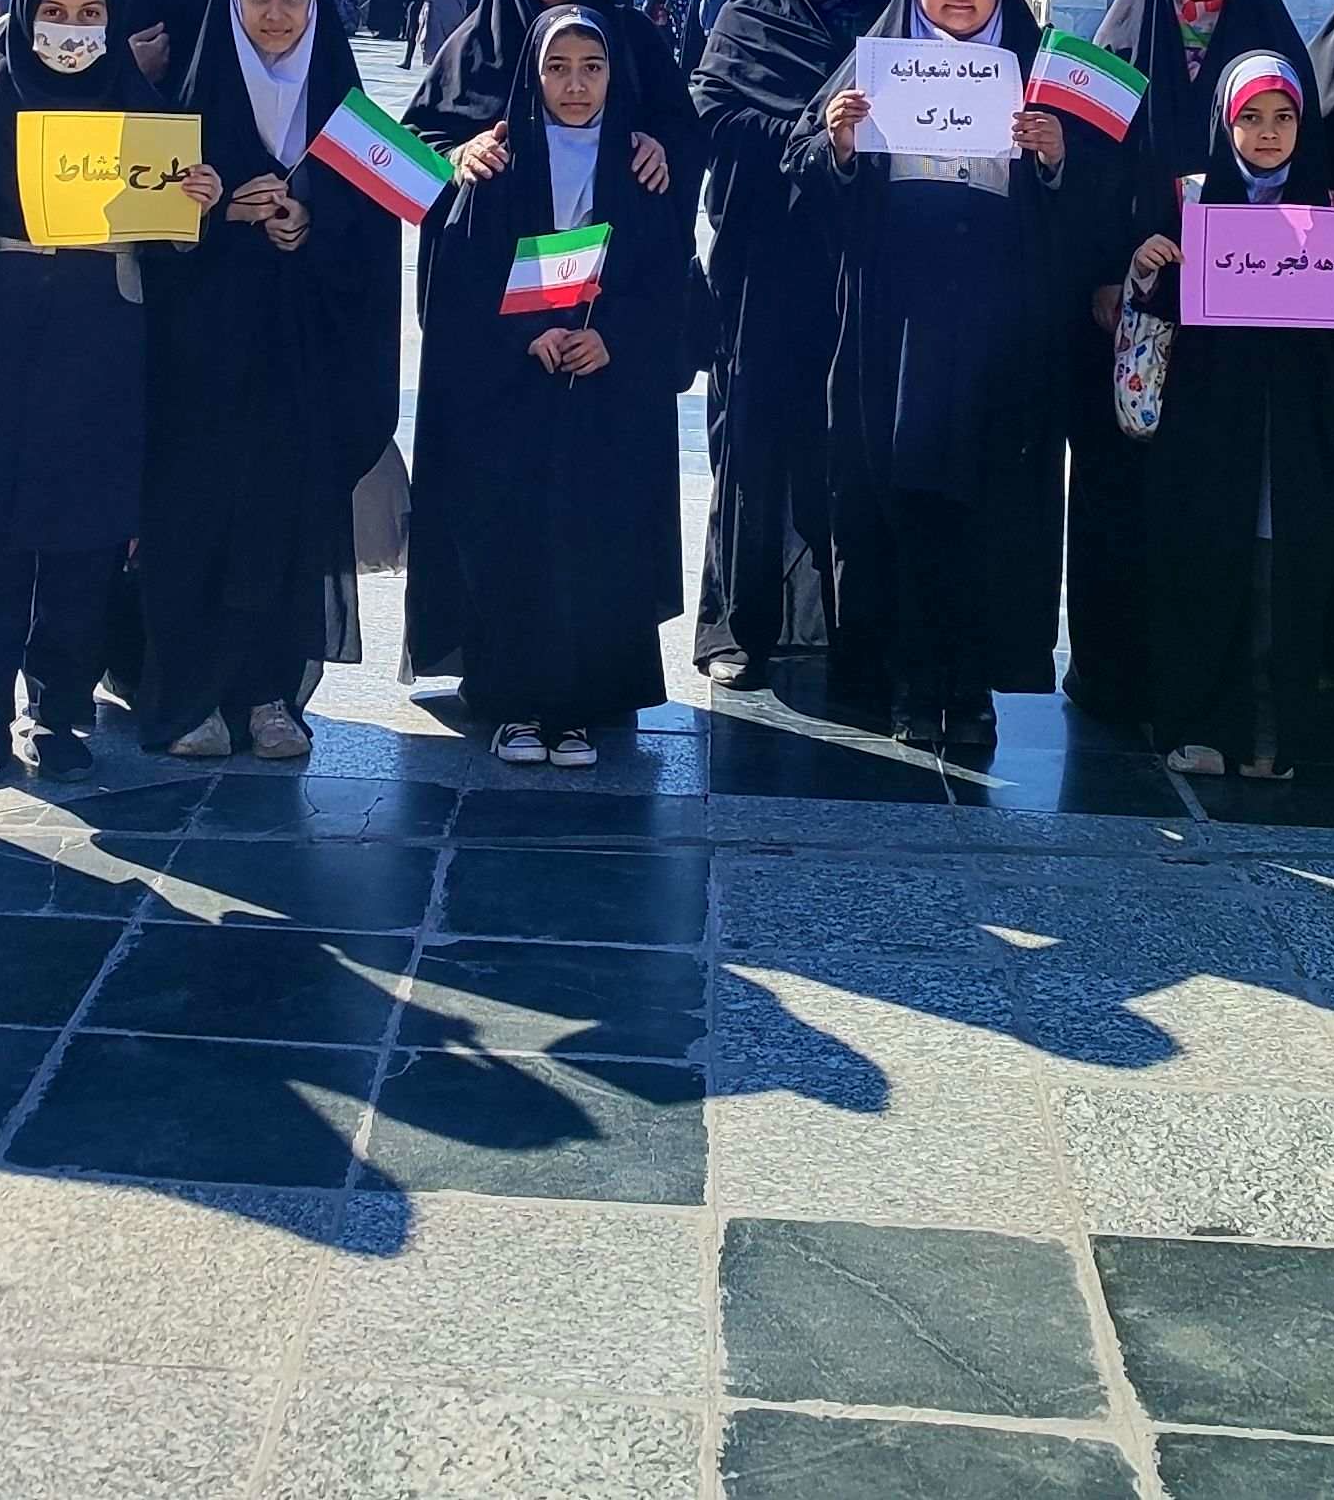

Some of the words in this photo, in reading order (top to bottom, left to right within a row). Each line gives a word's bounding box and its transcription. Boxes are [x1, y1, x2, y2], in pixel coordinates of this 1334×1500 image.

[890, 58, 951, 83] شعبانیه
[956, 61, 999, 83] اعیاد
[916, 107, 972, 131] مبارک
[54, 153, 121, 182] نشاط
[128, 156, 191, 191] طرح
[1215, 252, 1266, 274] مبارک
[1271, 249, 1309, 277] فجر
